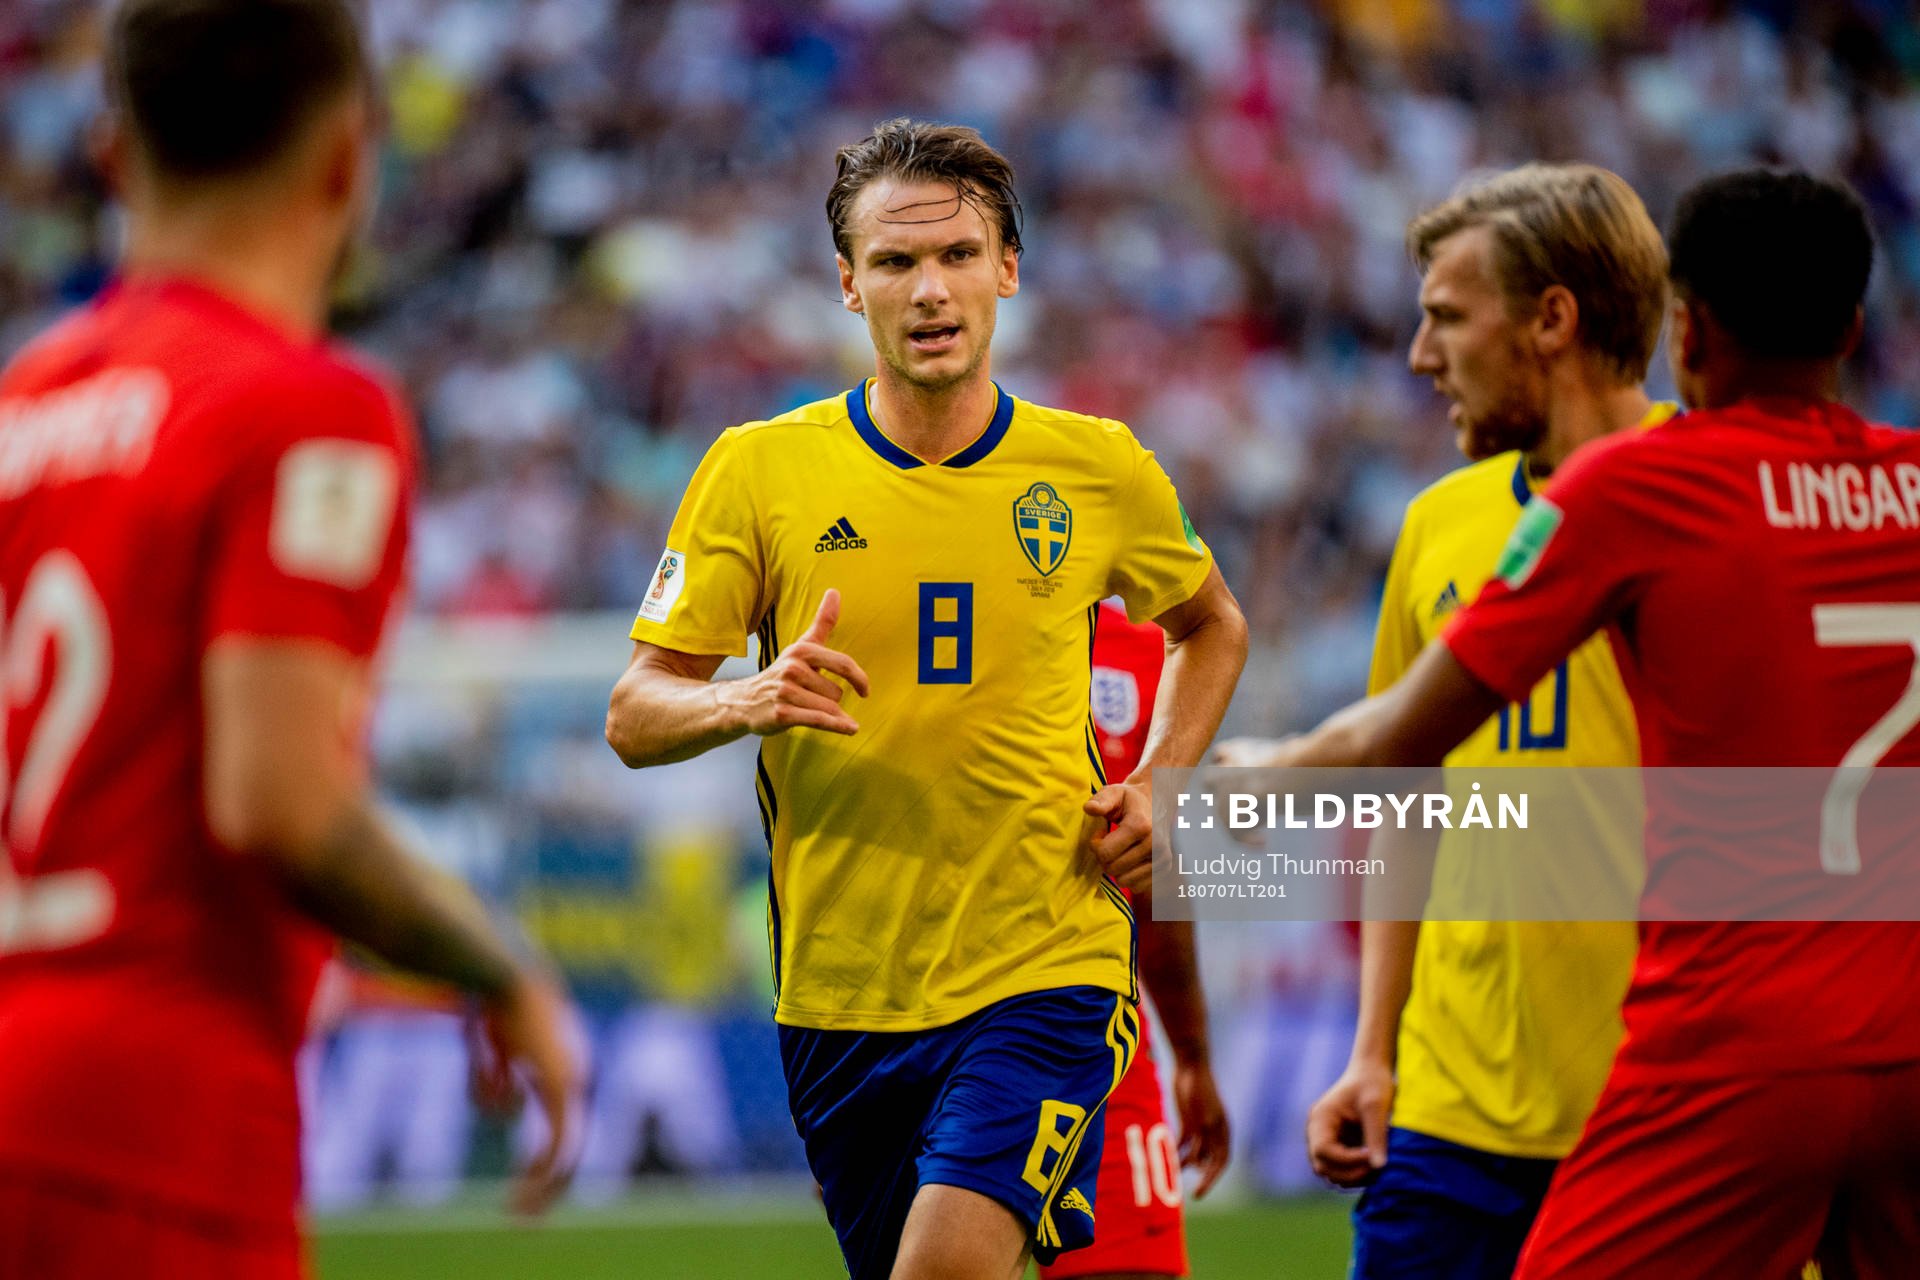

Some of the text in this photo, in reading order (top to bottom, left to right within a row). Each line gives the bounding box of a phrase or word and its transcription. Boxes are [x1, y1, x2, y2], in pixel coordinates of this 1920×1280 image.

[814, 538, 867, 553] adidas
[1025, 508, 1062, 519] SVERIGE
[918, 582, 973, 684] 8
[0, 547, 116, 957] 2
[1812, 602, 1920, 876] 7
[1125, 1122, 1183, 1208] 10
